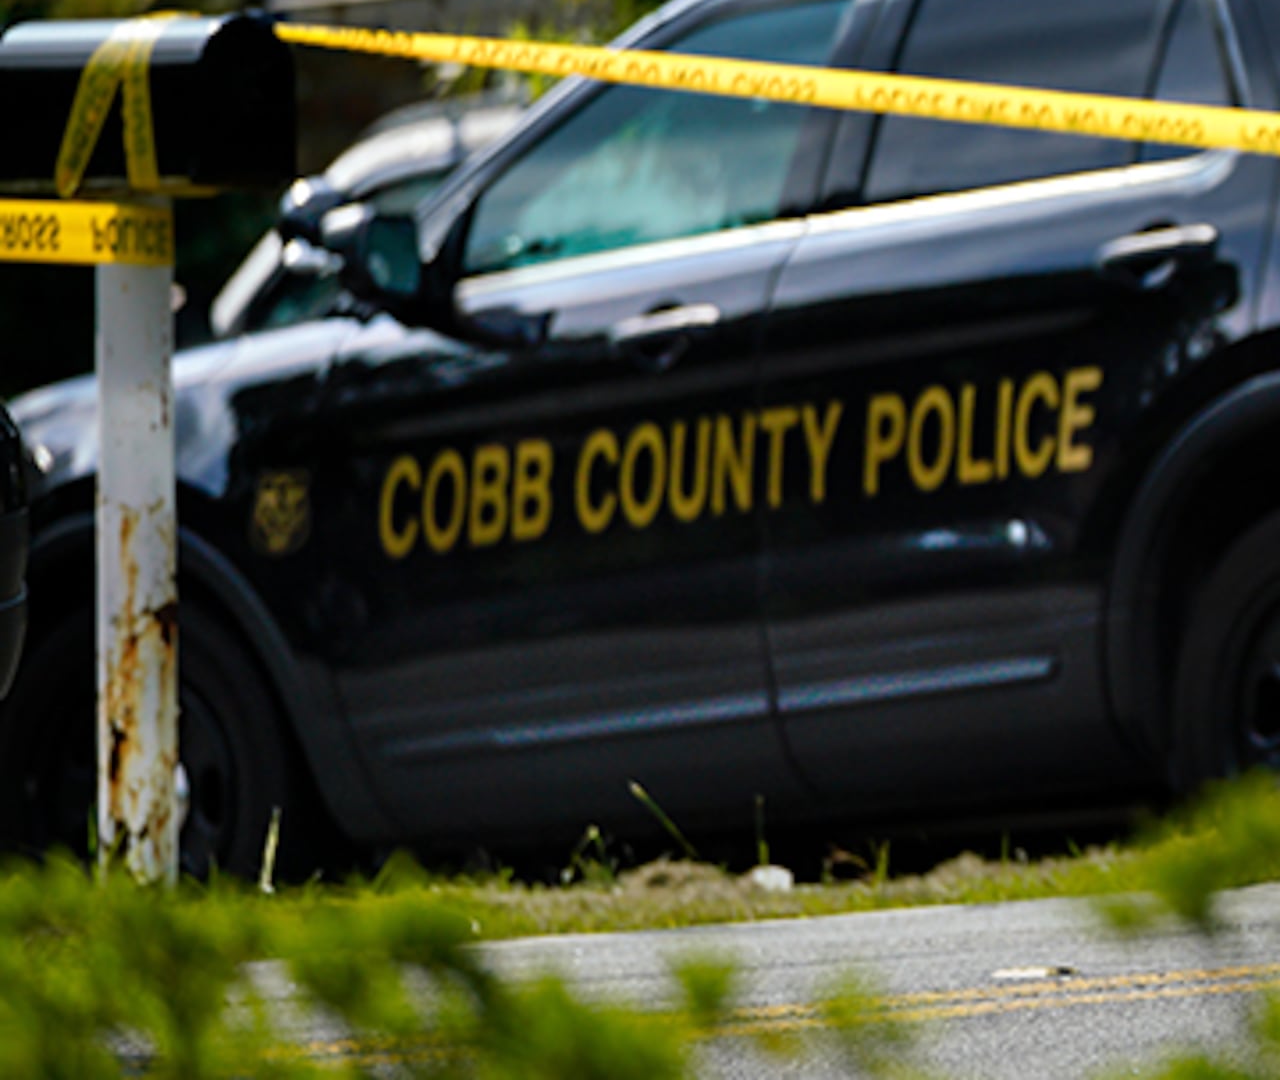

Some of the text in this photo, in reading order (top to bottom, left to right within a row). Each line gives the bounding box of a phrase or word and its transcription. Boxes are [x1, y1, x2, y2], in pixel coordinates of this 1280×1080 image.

[378, 366, 1102, 560] COBB COUNTY POLICE
